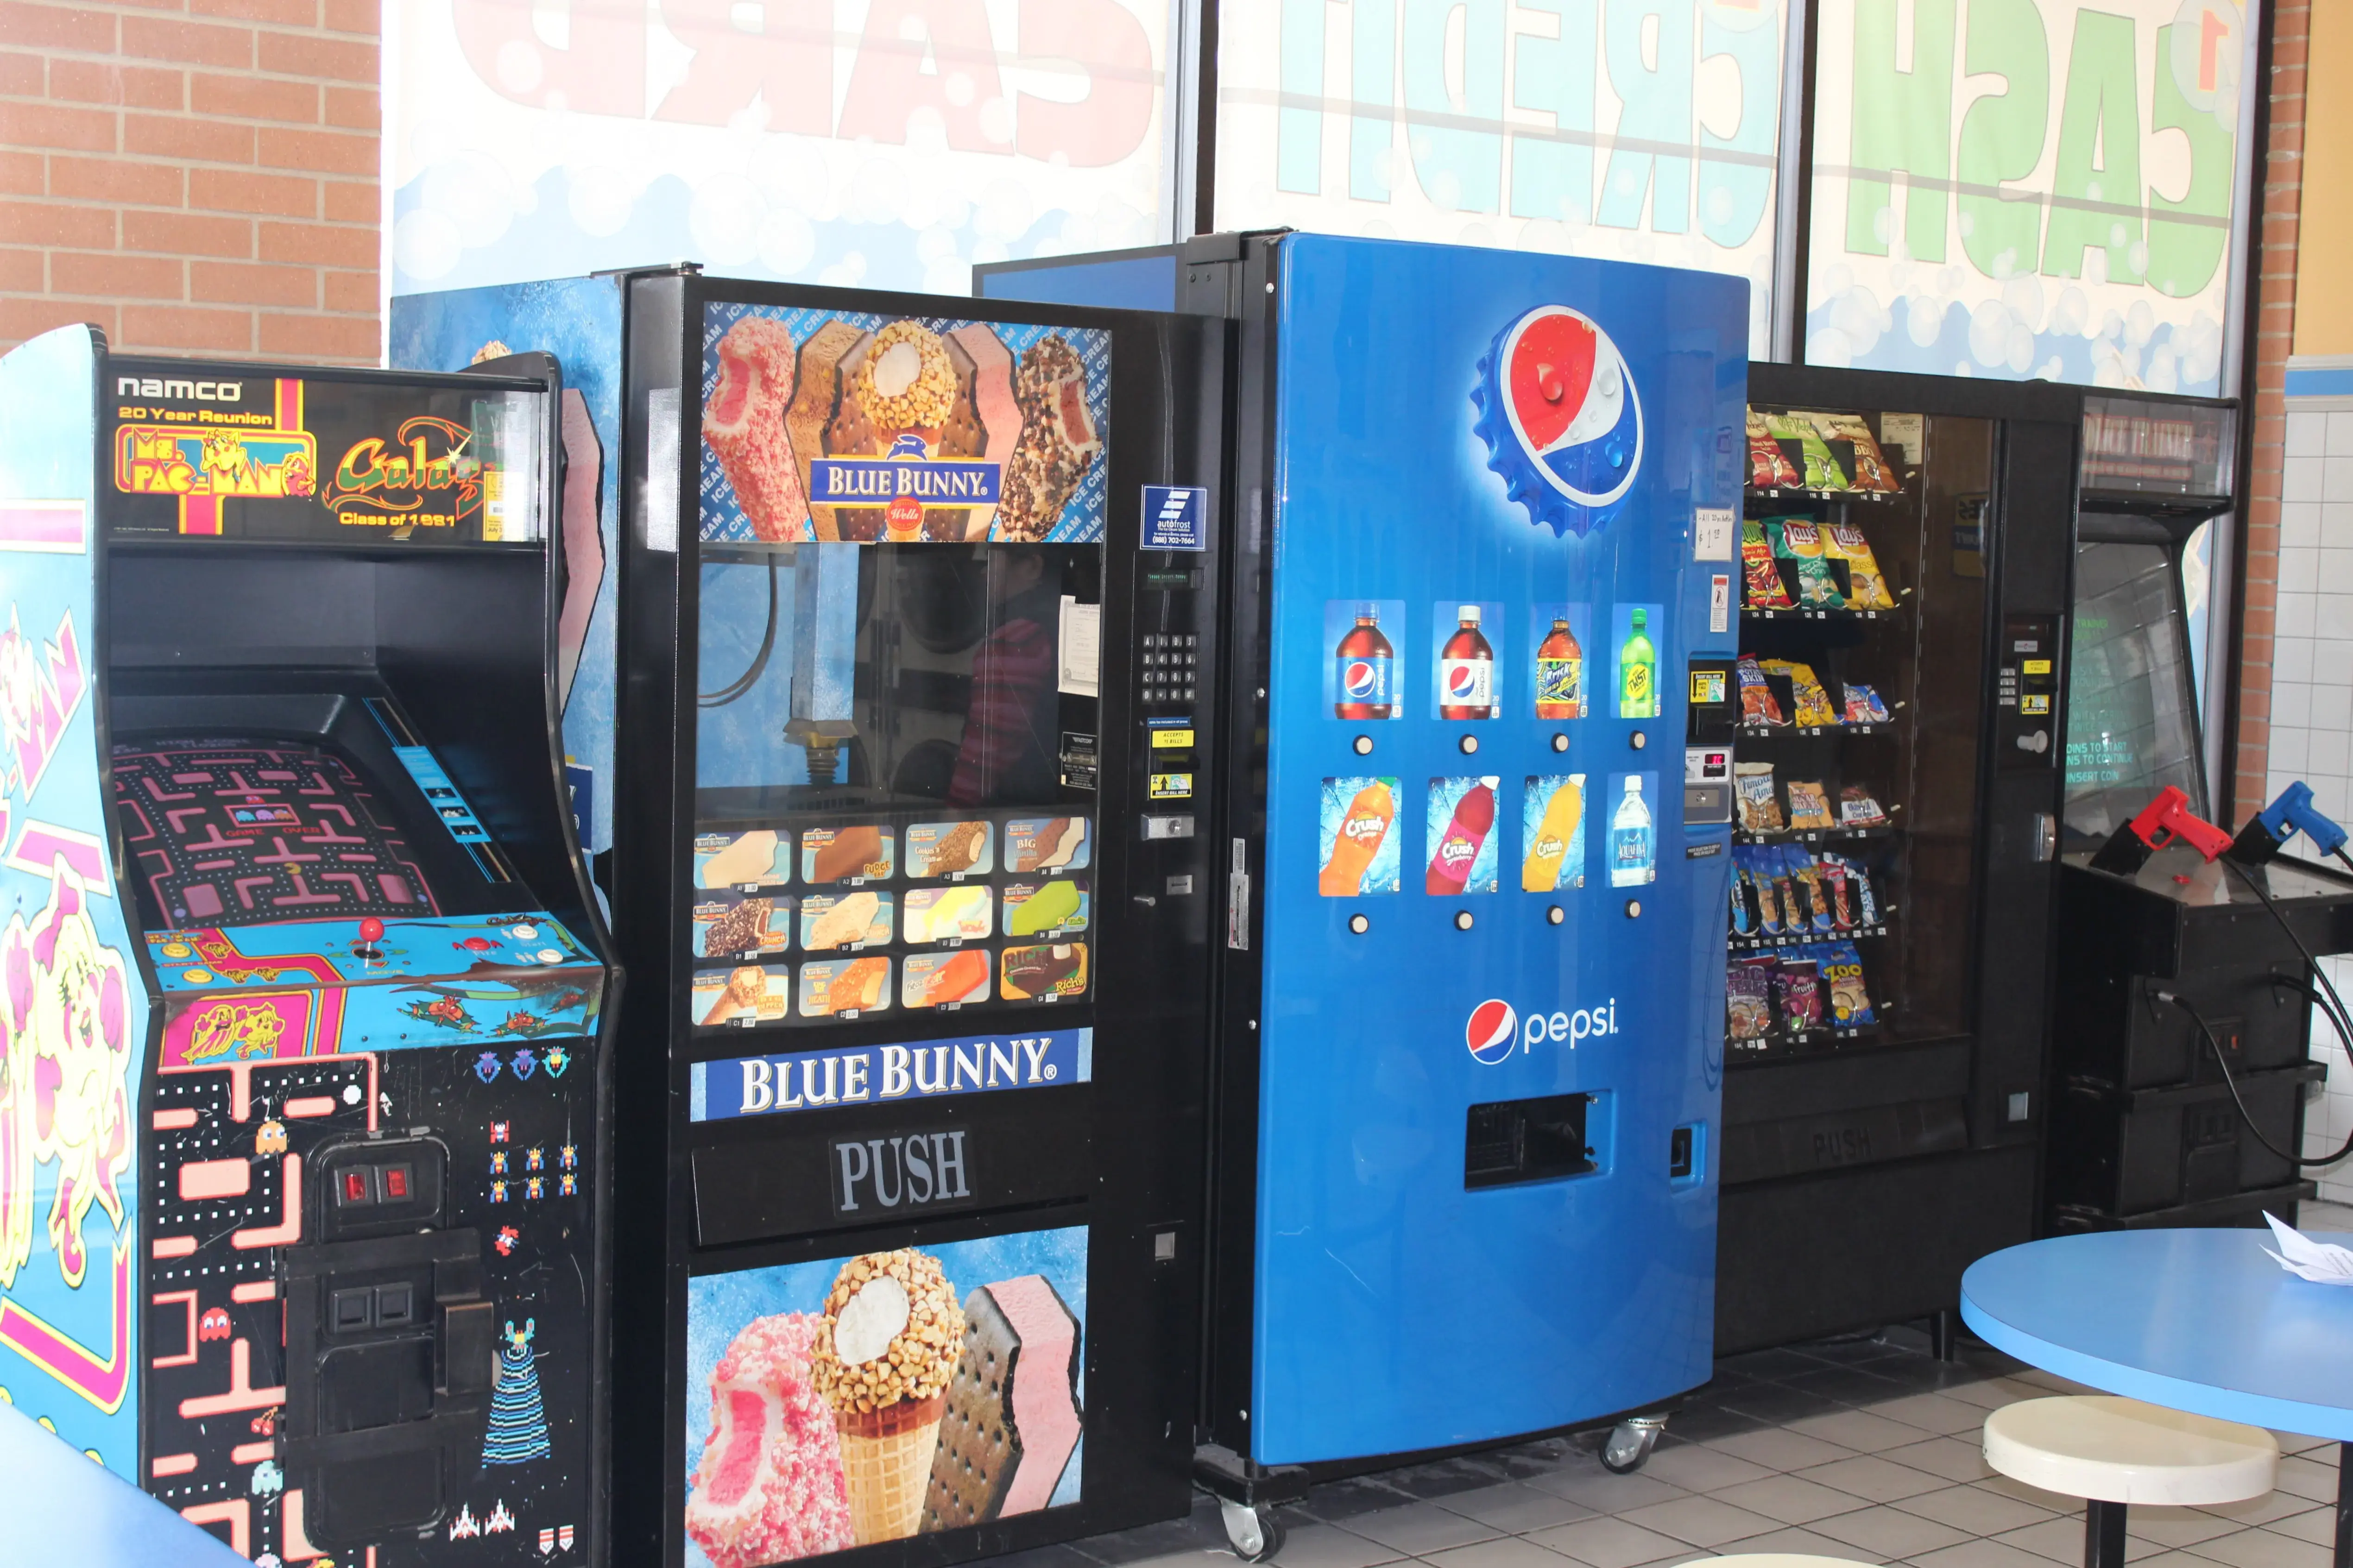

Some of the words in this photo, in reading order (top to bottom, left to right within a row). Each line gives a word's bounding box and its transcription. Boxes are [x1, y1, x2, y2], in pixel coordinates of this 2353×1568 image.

[118, 377, 241, 402] namco
[119, 407, 146, 419] 20
[150, 408, 196, 422] Year
[199, 410, 272, 425] Reunion
[336, 435, 504, 521] Galag
[827, 466, 893, 495] BLUE
[896, 467, 985, 496] BUNNY
[339, 512, 388, 526] Class
[390, 513, 406, 526] of
[409, 512, 456, 527] 1981
[890, 508, 919, 520] Wells
[1157, 519, 1190, 529] autofrost
[1153, 535, 1167, 544] (888)
[1786, 524, 1819, 546] Lay's
[1833, 527, 1864, 547] Lay's
[1146, 637, 1149, 646] A
[1161, 637, 1163, 646] 1
[1174, 637, 1177, 646] 2
[1188, 637, 1191, 646] 3
[1146, 655, 1149, 664] B
[1160, 655, 1163, 663] 4
[1174, 655, 1177, 663] 5
[1188, 655, 1191, 663] 6
[1145, 673, 1148, 681] C
[1173, 673, 1177, 681] 8
[1187, 673, 1191, 681] 9
[1376, 664, 1386, 696] pepsi
[1145, 691, 1149, 699] D
[1173, 690, 1176, 699] 0
[2067, 743, 2088, 754] OINS
[2090, 743, 2101, 752] TO
[2102, 742, 2127, 752] START
[2083, 754, 2094, 764] TO
[2067, 770, 2098, 783] INSERT
[2101, 770, 2119, 781] COIN
[226, 828, 265, 837] GAME
[1345, 816, 1384, 838] Crush
[915, 846, 934, 855] Cookies
[1016, 838, 1036, 849] BIG
[1442, 842, 1475, 860] Crush
[1536, 839, 1563, 857] Crush
[1618, 842, 1646, 860] AQUAFINA
[864, 860, 890, 873] FUDGE
[759, 934, 786, 945] CRUNCH
[1005, 950, 1048, 967] RICH
[1823, 963, 1862, 984] ZOO
[1055, 976, 1085, 993] Rich's
[1524, 997, 1615, 1054] pepsi
[740, 1053, 870, 1114] BLUE
[879, 1037, 1053, 1098] BUNNY
[836, 1130, 970, 1211] PUSH
